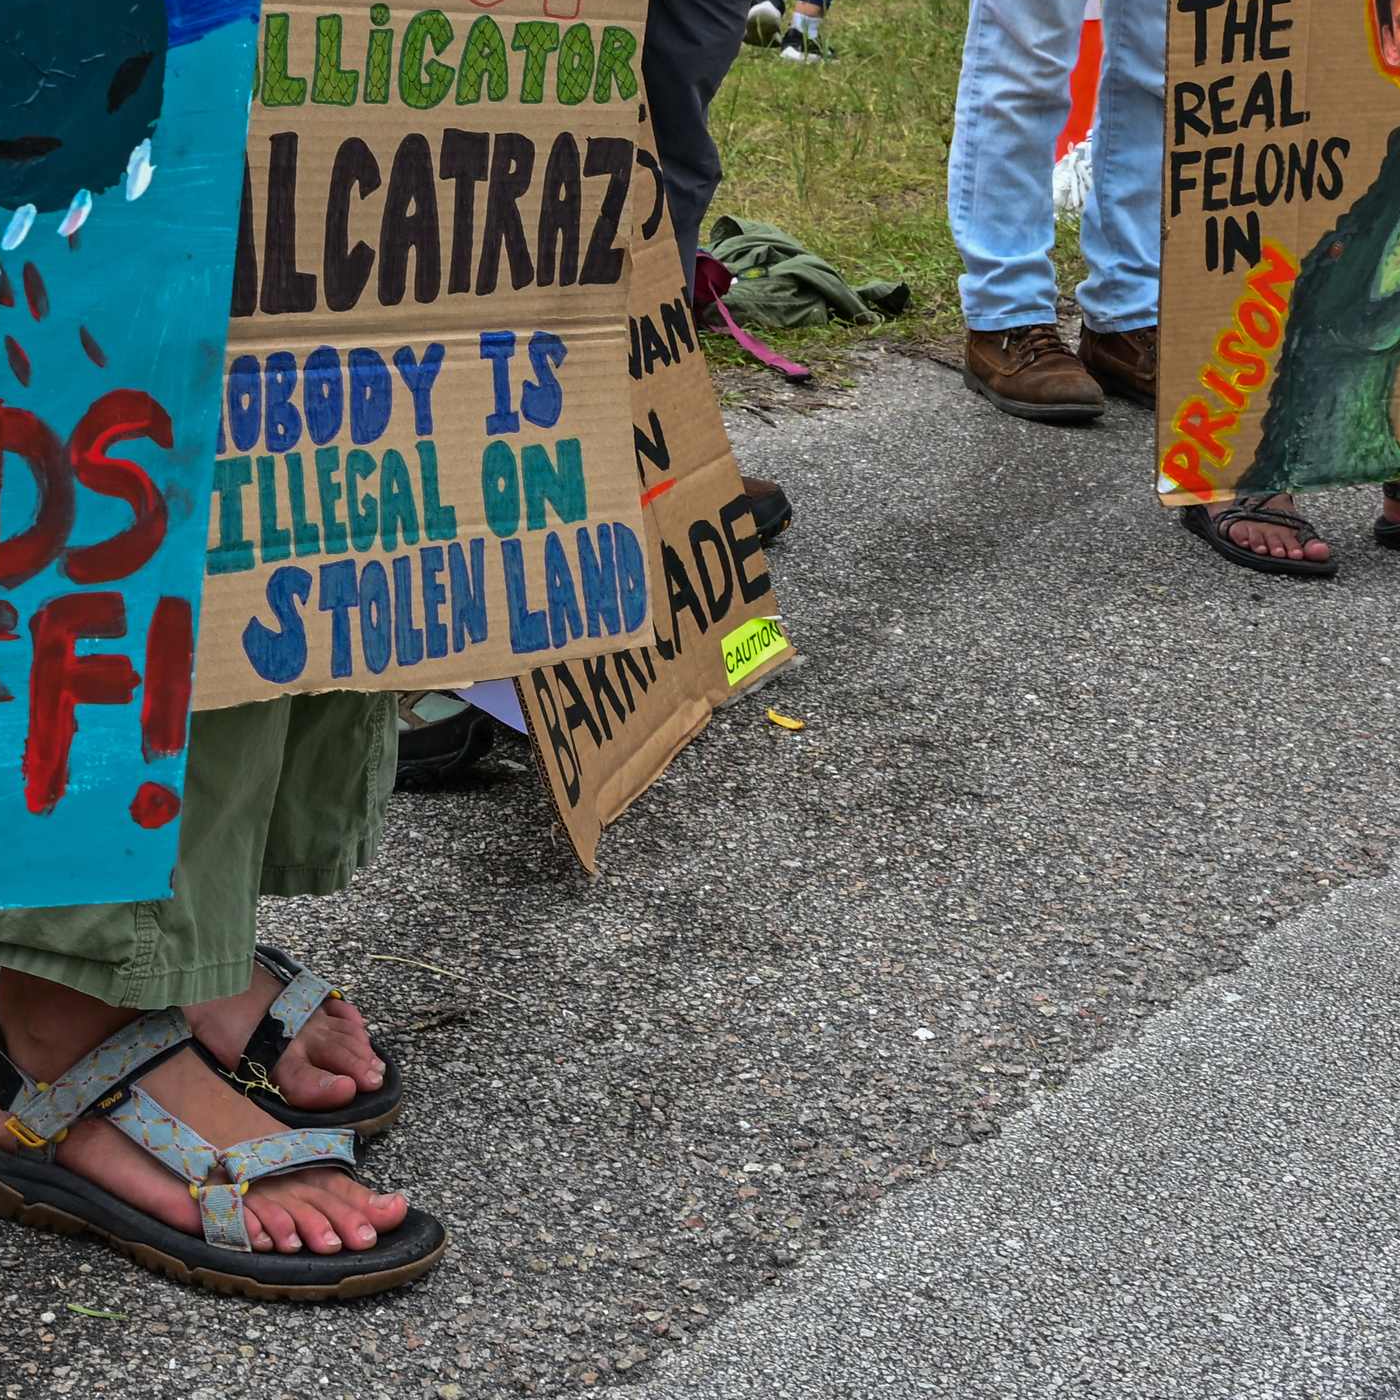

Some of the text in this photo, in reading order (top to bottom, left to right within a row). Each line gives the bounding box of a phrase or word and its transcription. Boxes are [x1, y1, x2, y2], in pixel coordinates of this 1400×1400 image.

[1173, 69, 1312, 147] REAL
[1170, 135, 1351, 218] FELONS
[1200, 209, 1264, 275] IN
[478, 330, 568, 437] IS
[1159, 237, 1301, 502] PRISON
[205, 437, 588, 576] ILLEGAL ON
[241, 521, 646, 685] STOLEN LAND
[725, 619, 783, 674] CAUTION
